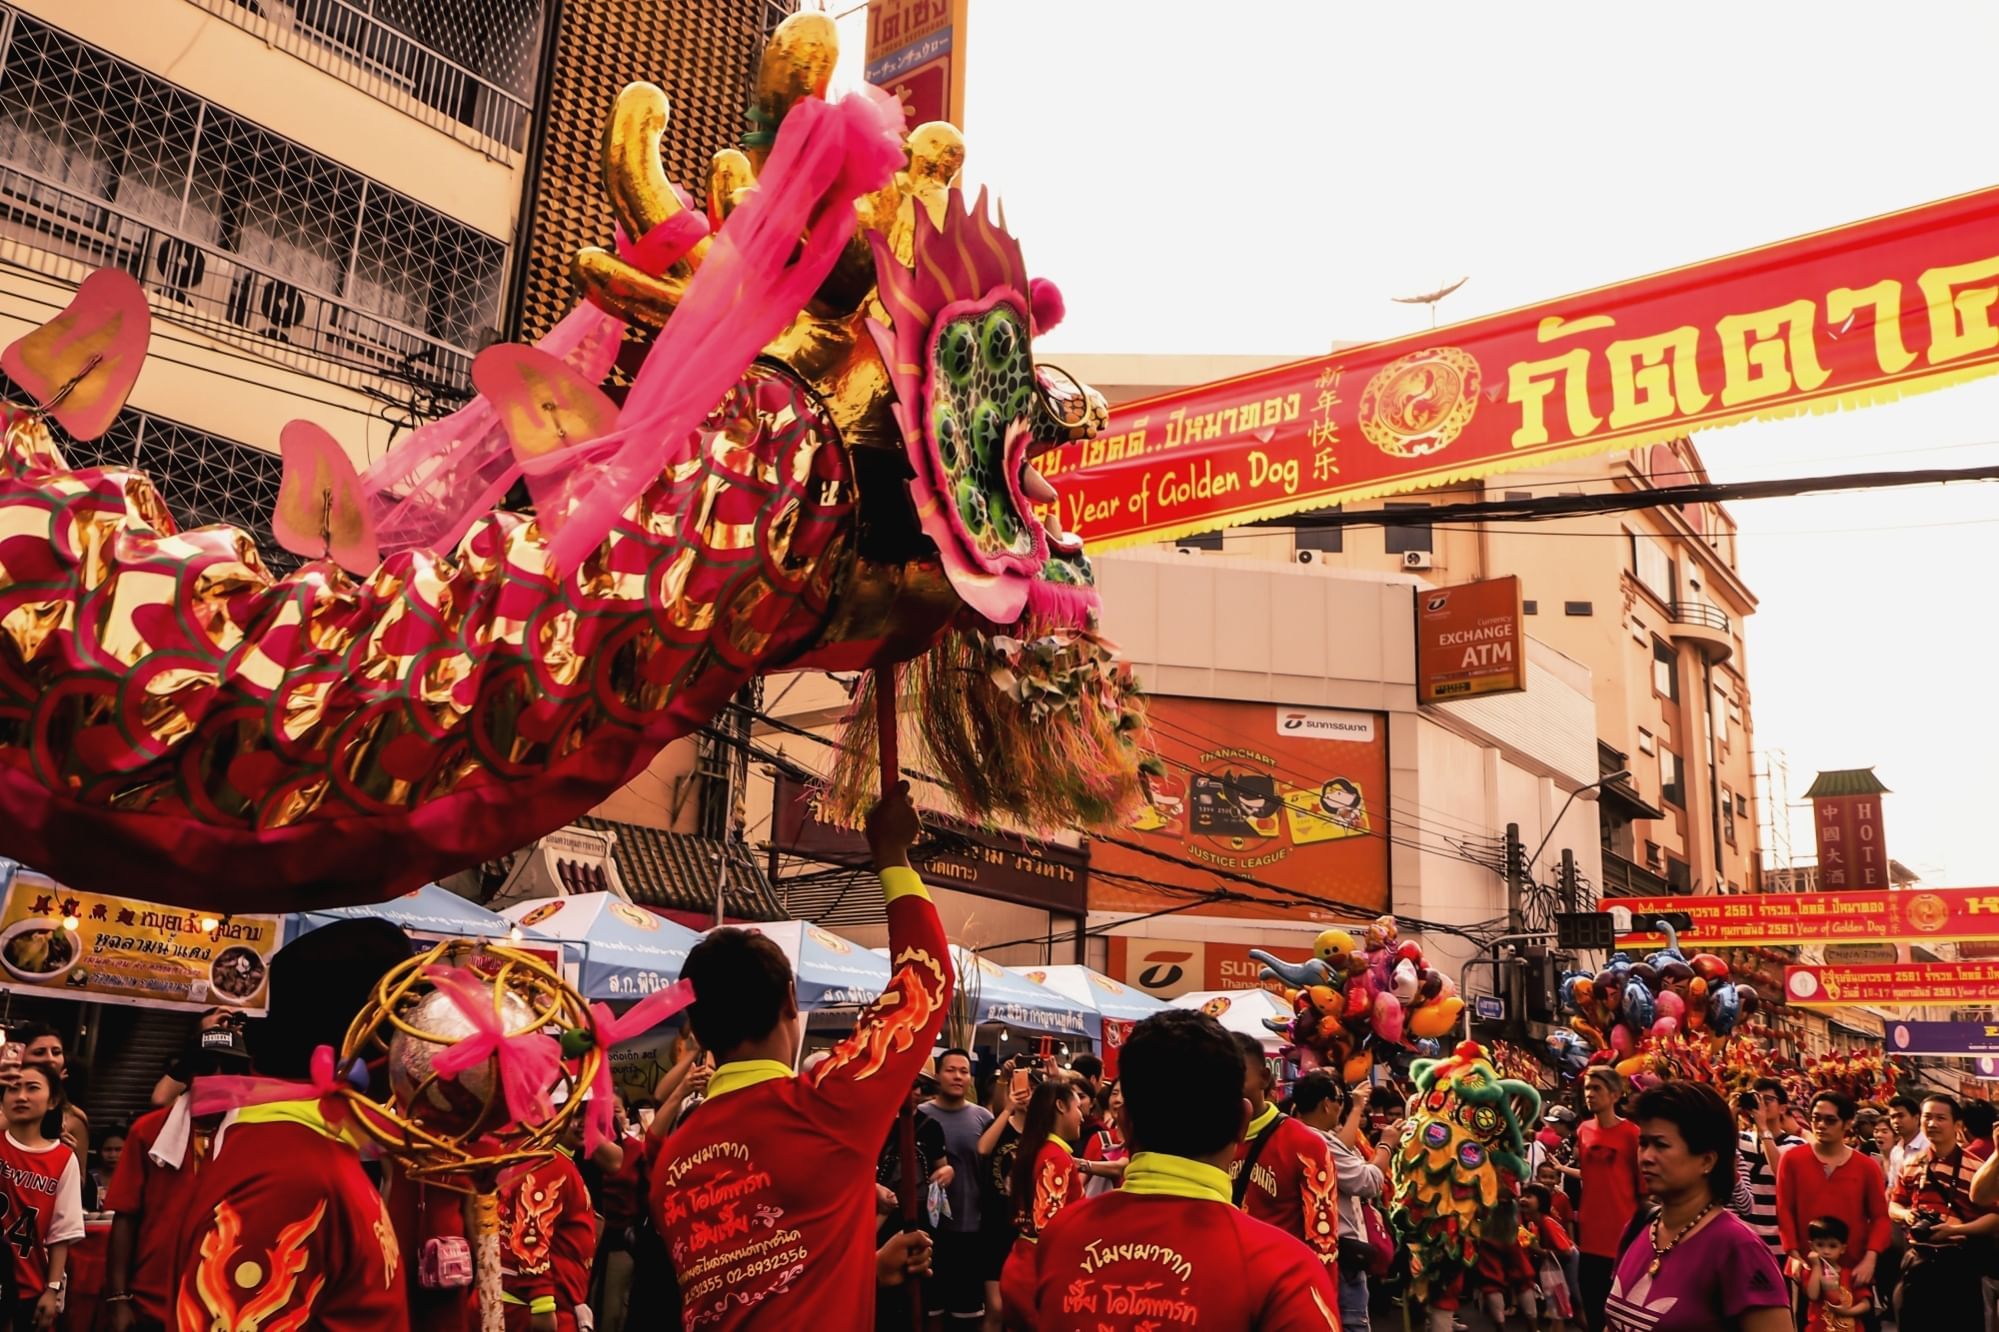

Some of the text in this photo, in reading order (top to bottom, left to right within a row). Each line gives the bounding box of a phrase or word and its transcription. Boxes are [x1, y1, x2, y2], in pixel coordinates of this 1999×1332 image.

[1307, 366, 1345, 481] 新年快乐
[1068, 491, 1120, 533] Year
[1128, 472, 1151, 525] of
[1157, 460, 1240, 506] Golden
[1248, 451, 1298, 494] Dog
[1439, 623, 1513, 646] EXCHANGE
[1461, 641, 1512, 668] ATM
[1199, 749, 1277, 768] THANACHART
[1187, 845, 1287, 868] JUSTICE LEAGUE
[1822, 804, 1846, 885] 中國大酒
[1856, 803, 1876, 885] HOTE
[1724, 904, 1754, 917] 2561
[1768, 923, 1794, 935] 2561
[1796, 921, 1818, 936] Year
[1821, 921, 1830, 935] of
[1832, 920, 1864, 933] Golden
[1867, 920, 1886, 936] Dog
[1957, 986, 1977, 999] Year
[666, 1141, 749, 1188] ขโมยมาจาก
[726, 1246, 808, 1284] 02-8932356
[1080, 1238, 1192, 1282] ขโมยมาจาก
